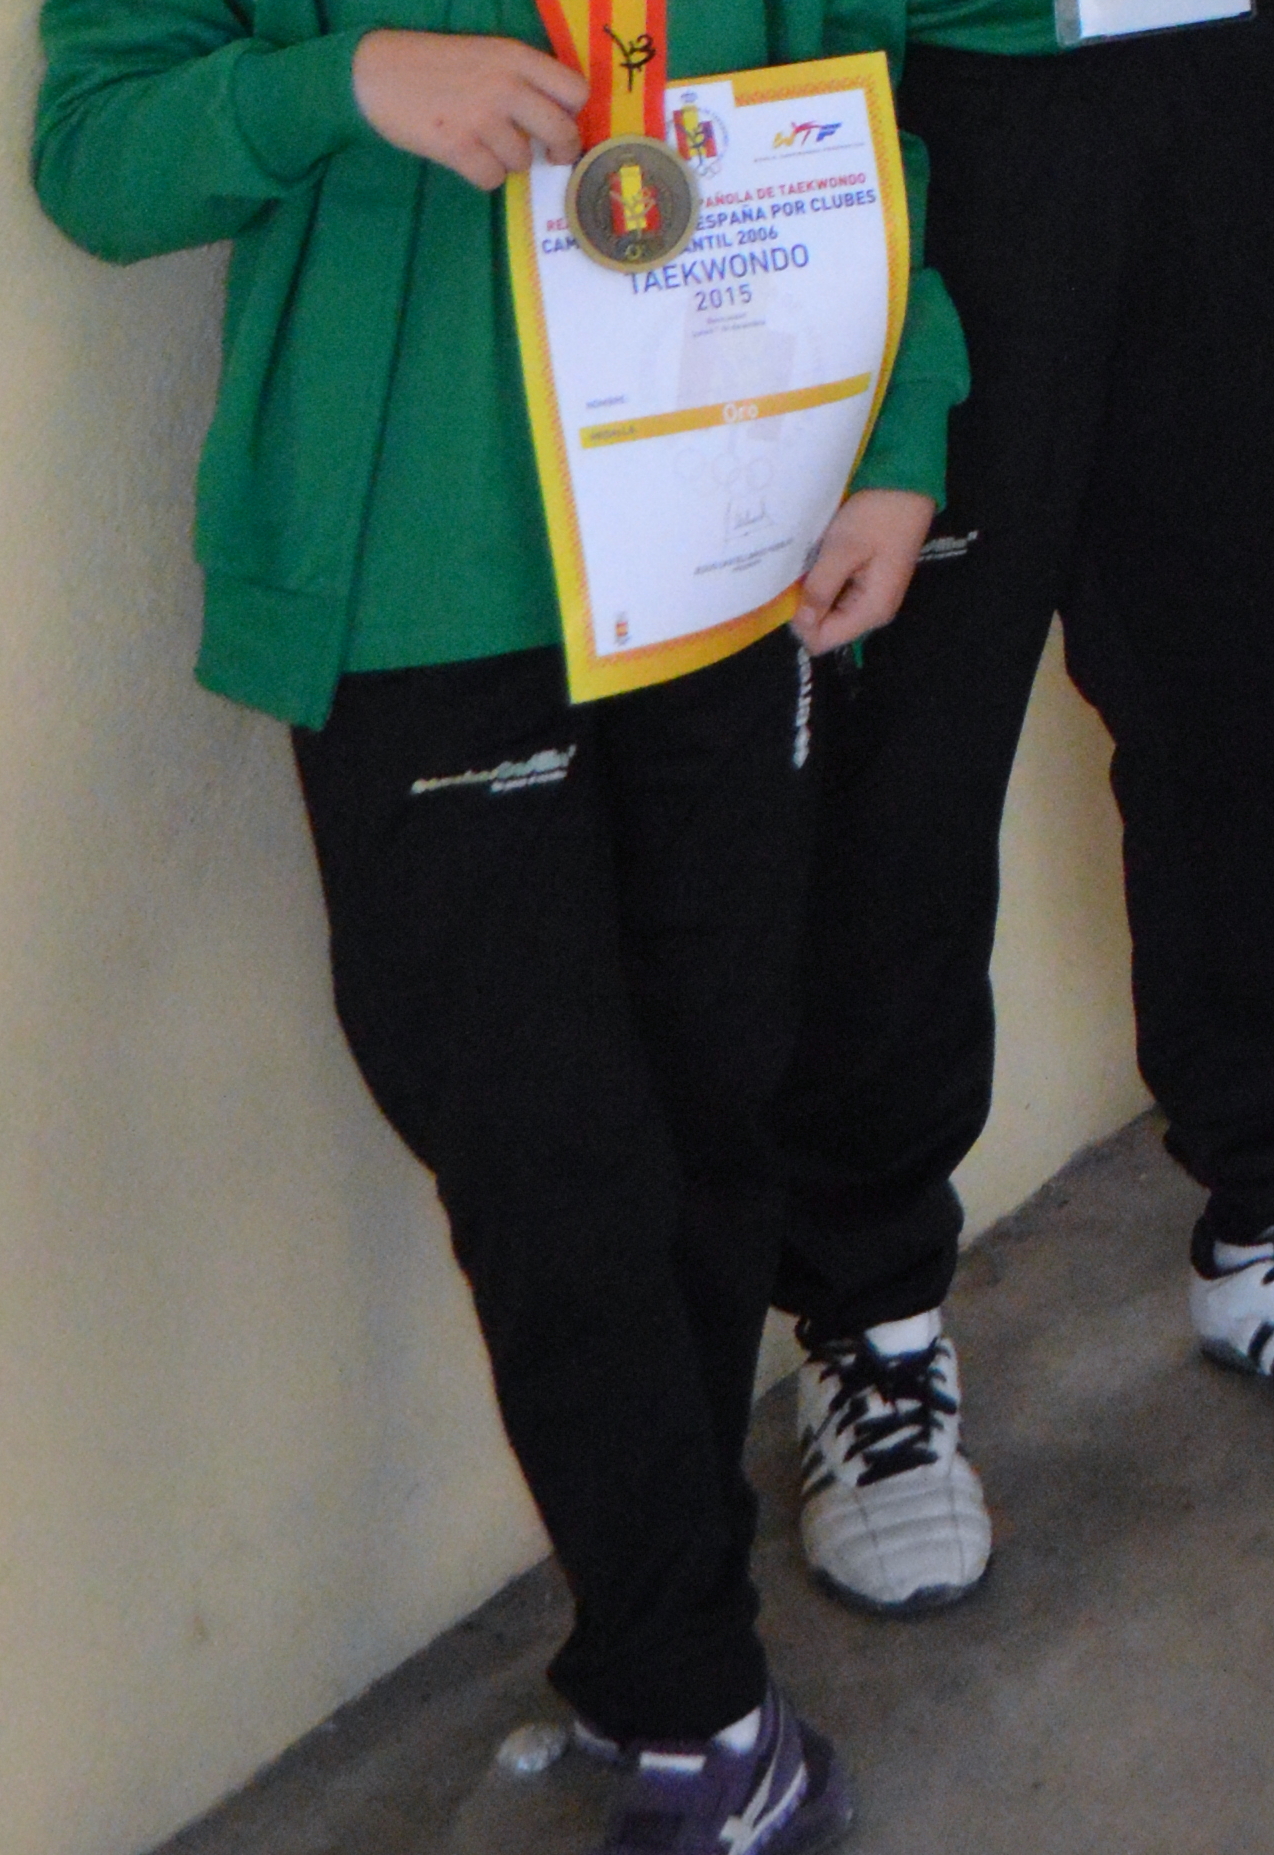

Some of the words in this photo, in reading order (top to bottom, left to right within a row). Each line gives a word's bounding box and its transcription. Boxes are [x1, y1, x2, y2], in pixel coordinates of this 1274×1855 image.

[756, 188, 776, 201] DE
[779, 173, 867, 195] TAEKWONDO
[771, 200, 806, 219] POR
[810, 189, 877, 212] CLUBES
[737, 226, 778, 245] 2006
[625, 243, 810, 294] TAEKWONDO
[695, 283, 752, 312] 2015
[723, 402, 759, 425] Oro
